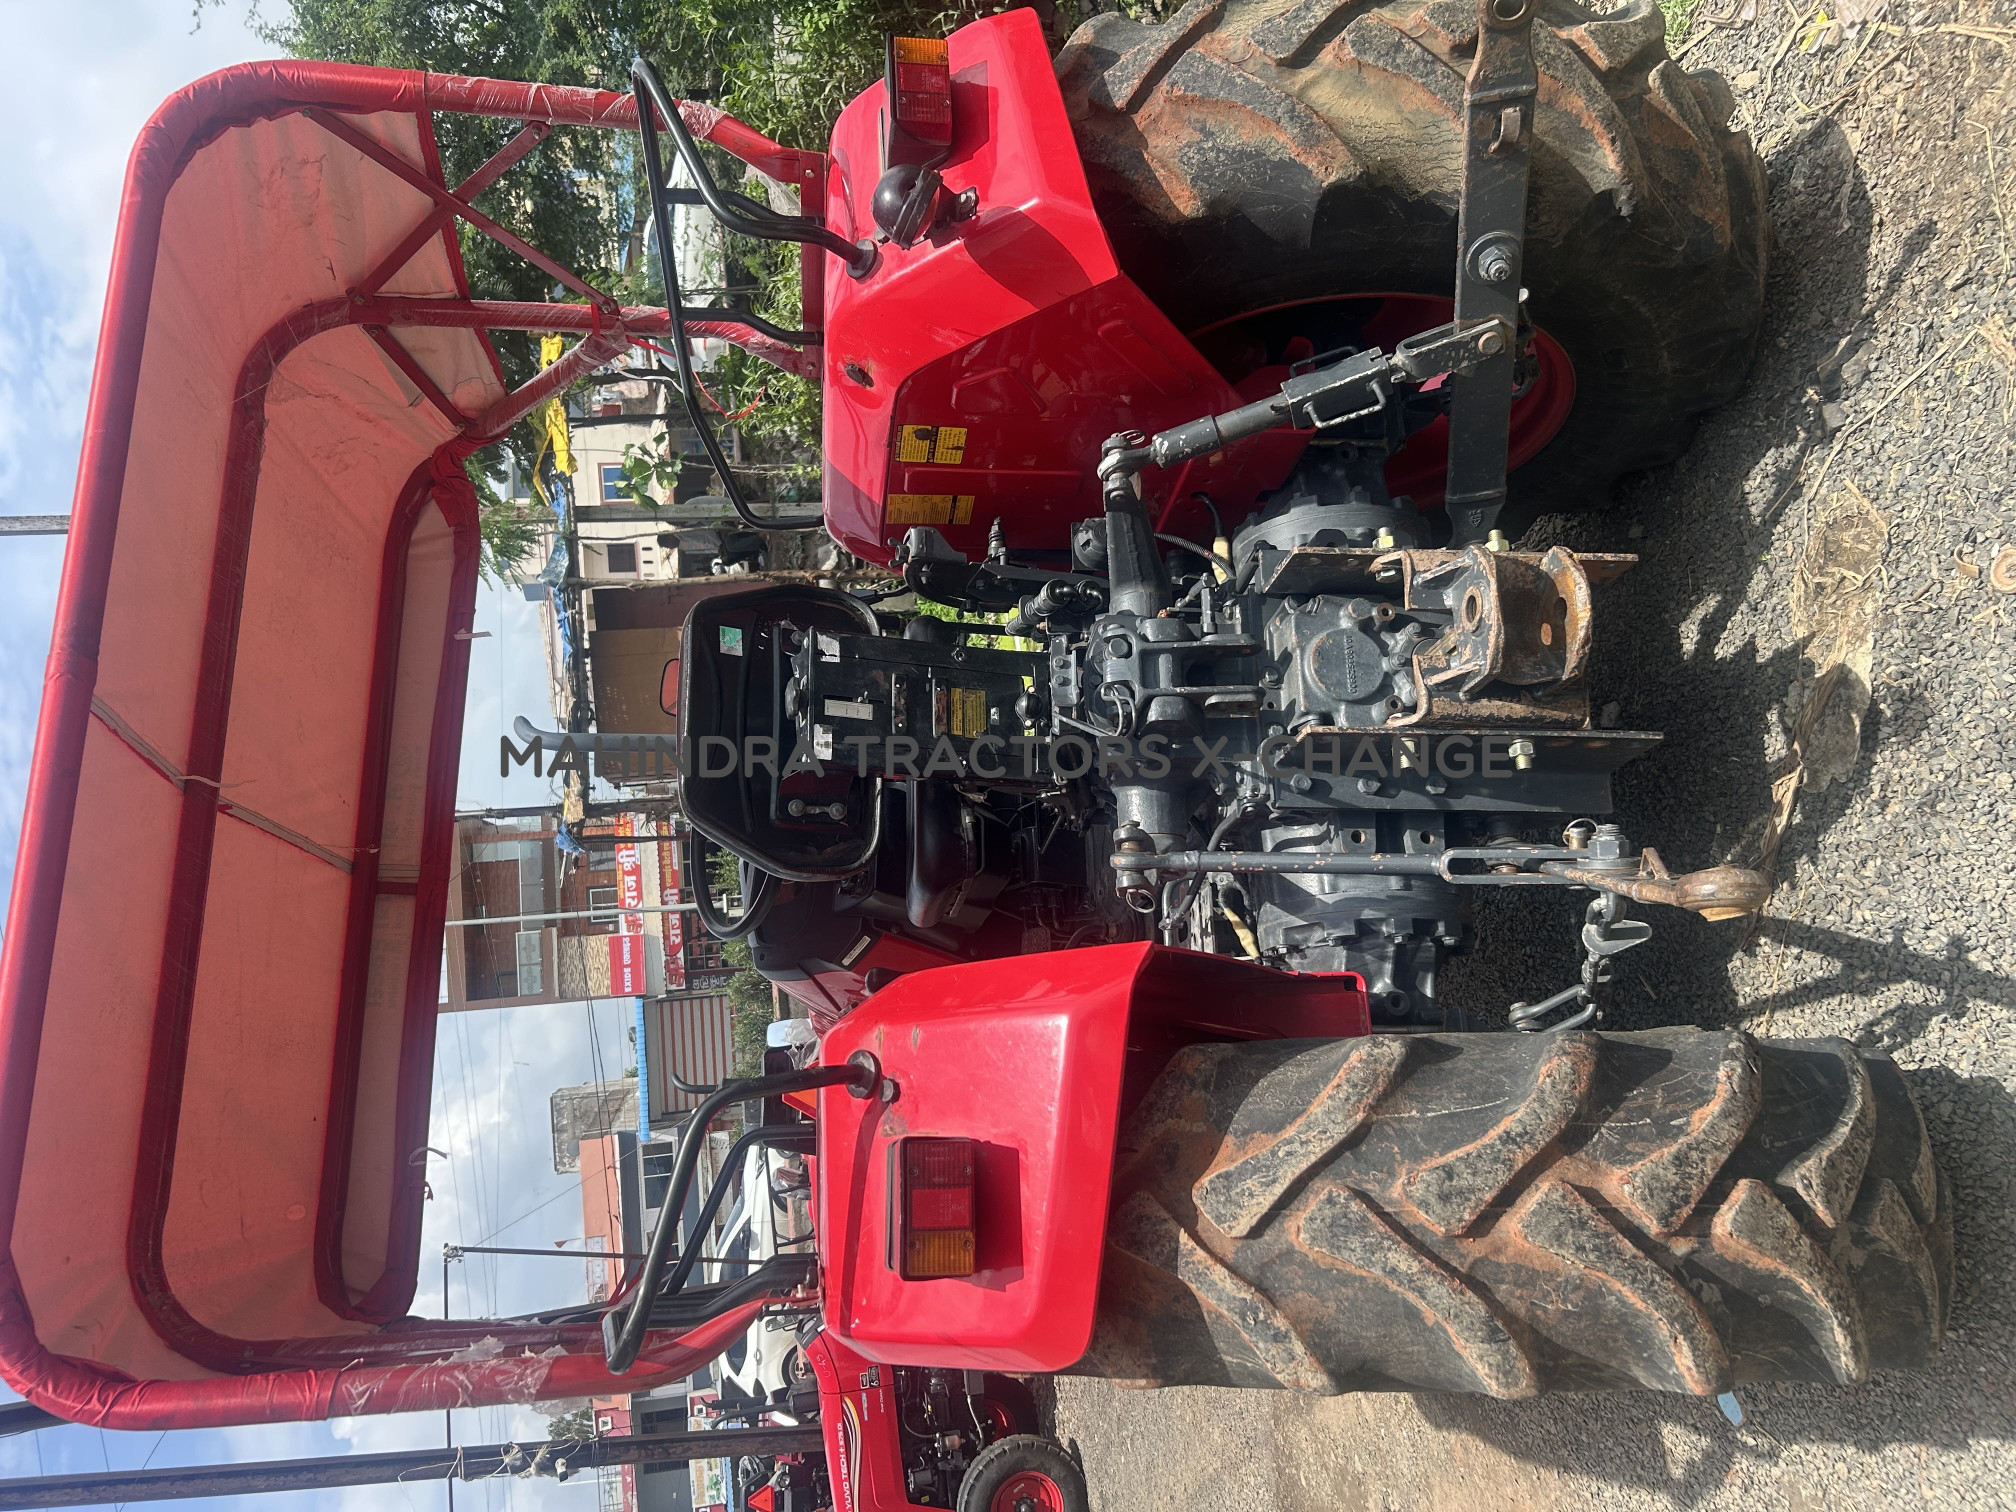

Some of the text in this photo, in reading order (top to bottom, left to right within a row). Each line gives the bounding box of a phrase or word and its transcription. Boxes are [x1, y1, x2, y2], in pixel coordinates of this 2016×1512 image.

[618, 849, 636, 871] श्री
[624, 874, 638, 908] राज
[668, 912, 681, 945] राज
[624, 968, 632, 992] EXIDE
[840, 1454, 849, 1479] TECH
[842, 1482, 852, 1508] YUVO
